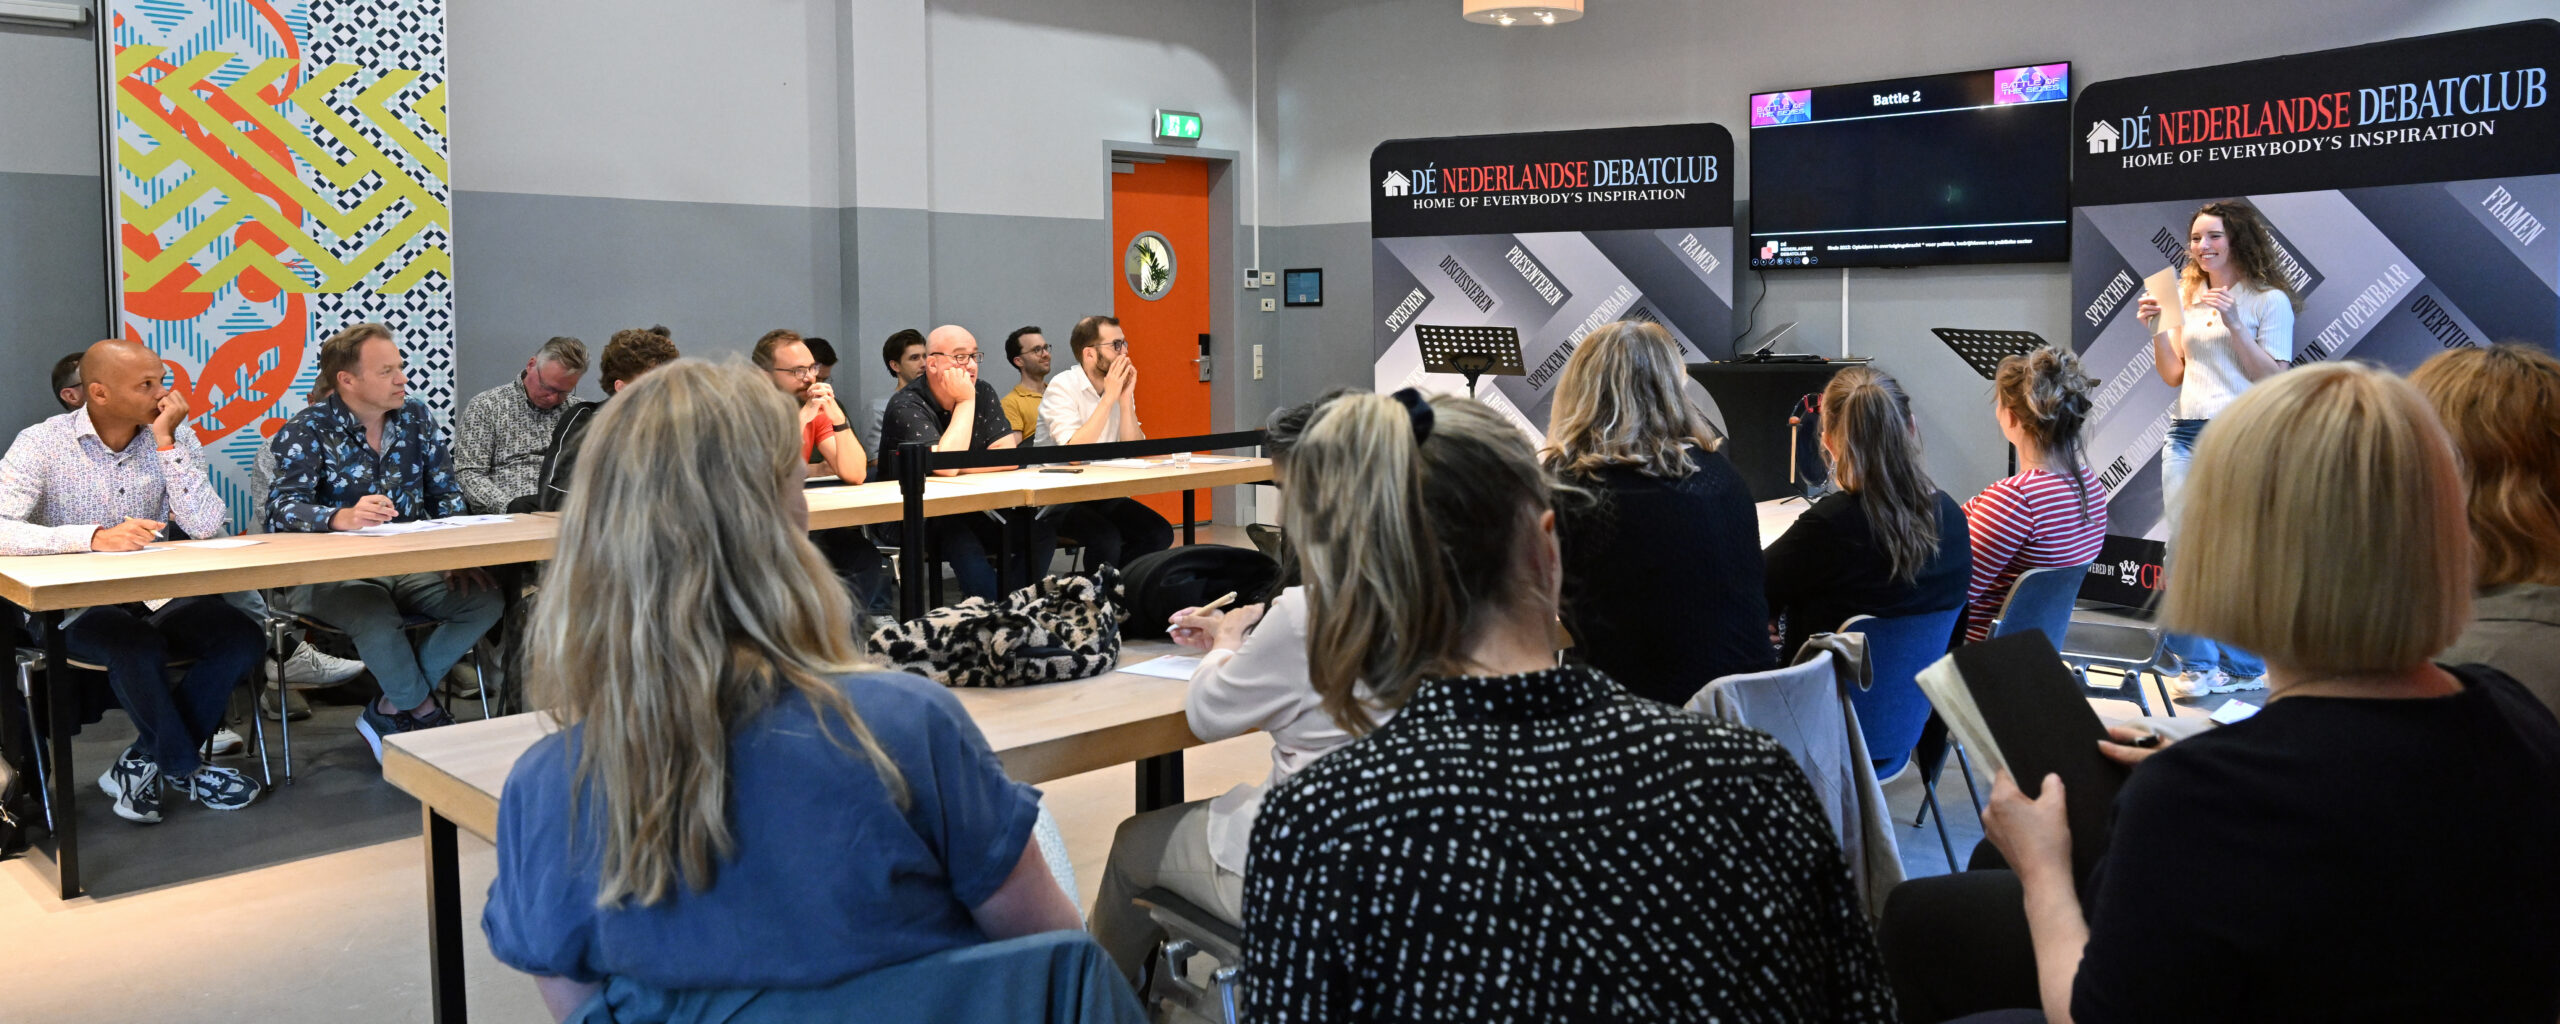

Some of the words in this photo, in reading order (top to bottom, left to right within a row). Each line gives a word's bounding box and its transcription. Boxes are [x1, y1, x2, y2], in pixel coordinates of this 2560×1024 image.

[1873, 92, 1910, 106] Battle
[1912, 90, 1921, 103] 2
[2121, 106, 2151, 150] DÉ
[2158, 91, 2351, 147] NEDERLANDSE
[2357, 67, 2547, 126] DEBATCLUB
[2122, 152, 2174, 169] HOME
[2179, 149, 2204, 164] OF
[2208, 135, 2342, 162] EVERYBODY'S
[2350, 120, 2496, 148] INSPIRATION
[1412, 162, 1437, 195] DÉ
[1443, 161, 1589, 194] NEDERLANDSE
[1593, 155, 1718, 187] DEBATCLUB
[1413, 198, 1456, 209] HOME
[1459, 197, 1479, 208] OF
[1483, 192, 1583, 207] EVERYBODY'S
[1588, 188, 1686, 203] INSPIRATION
[2481, 185, 2546, 246] FRAMEN
[1505, 244, 1564, 307] PRESENTEREN
[1678, 232, 1720, 275] FRAMEN
[1439, 254, 1495, 314] DISCUSSIËREN
[2084, 269, 2135, 327] SPEECHEN
[1385, 287, 1427, 333] SPEECHEN
[2317, 318, 2350, 353] HET
[2342, 263, 2411, 330] OPENBAAR
[1526, 349, 1567, 391] SPREKEN
[1559, 340, 1575, 357] IN
[1585, 284, 1634, 331] OPENBAAR
[2099, 455, 2133, 493] NLINE
[2107, 564, 2115, 576] BY
[2141, 563, 2167, 591] CR
